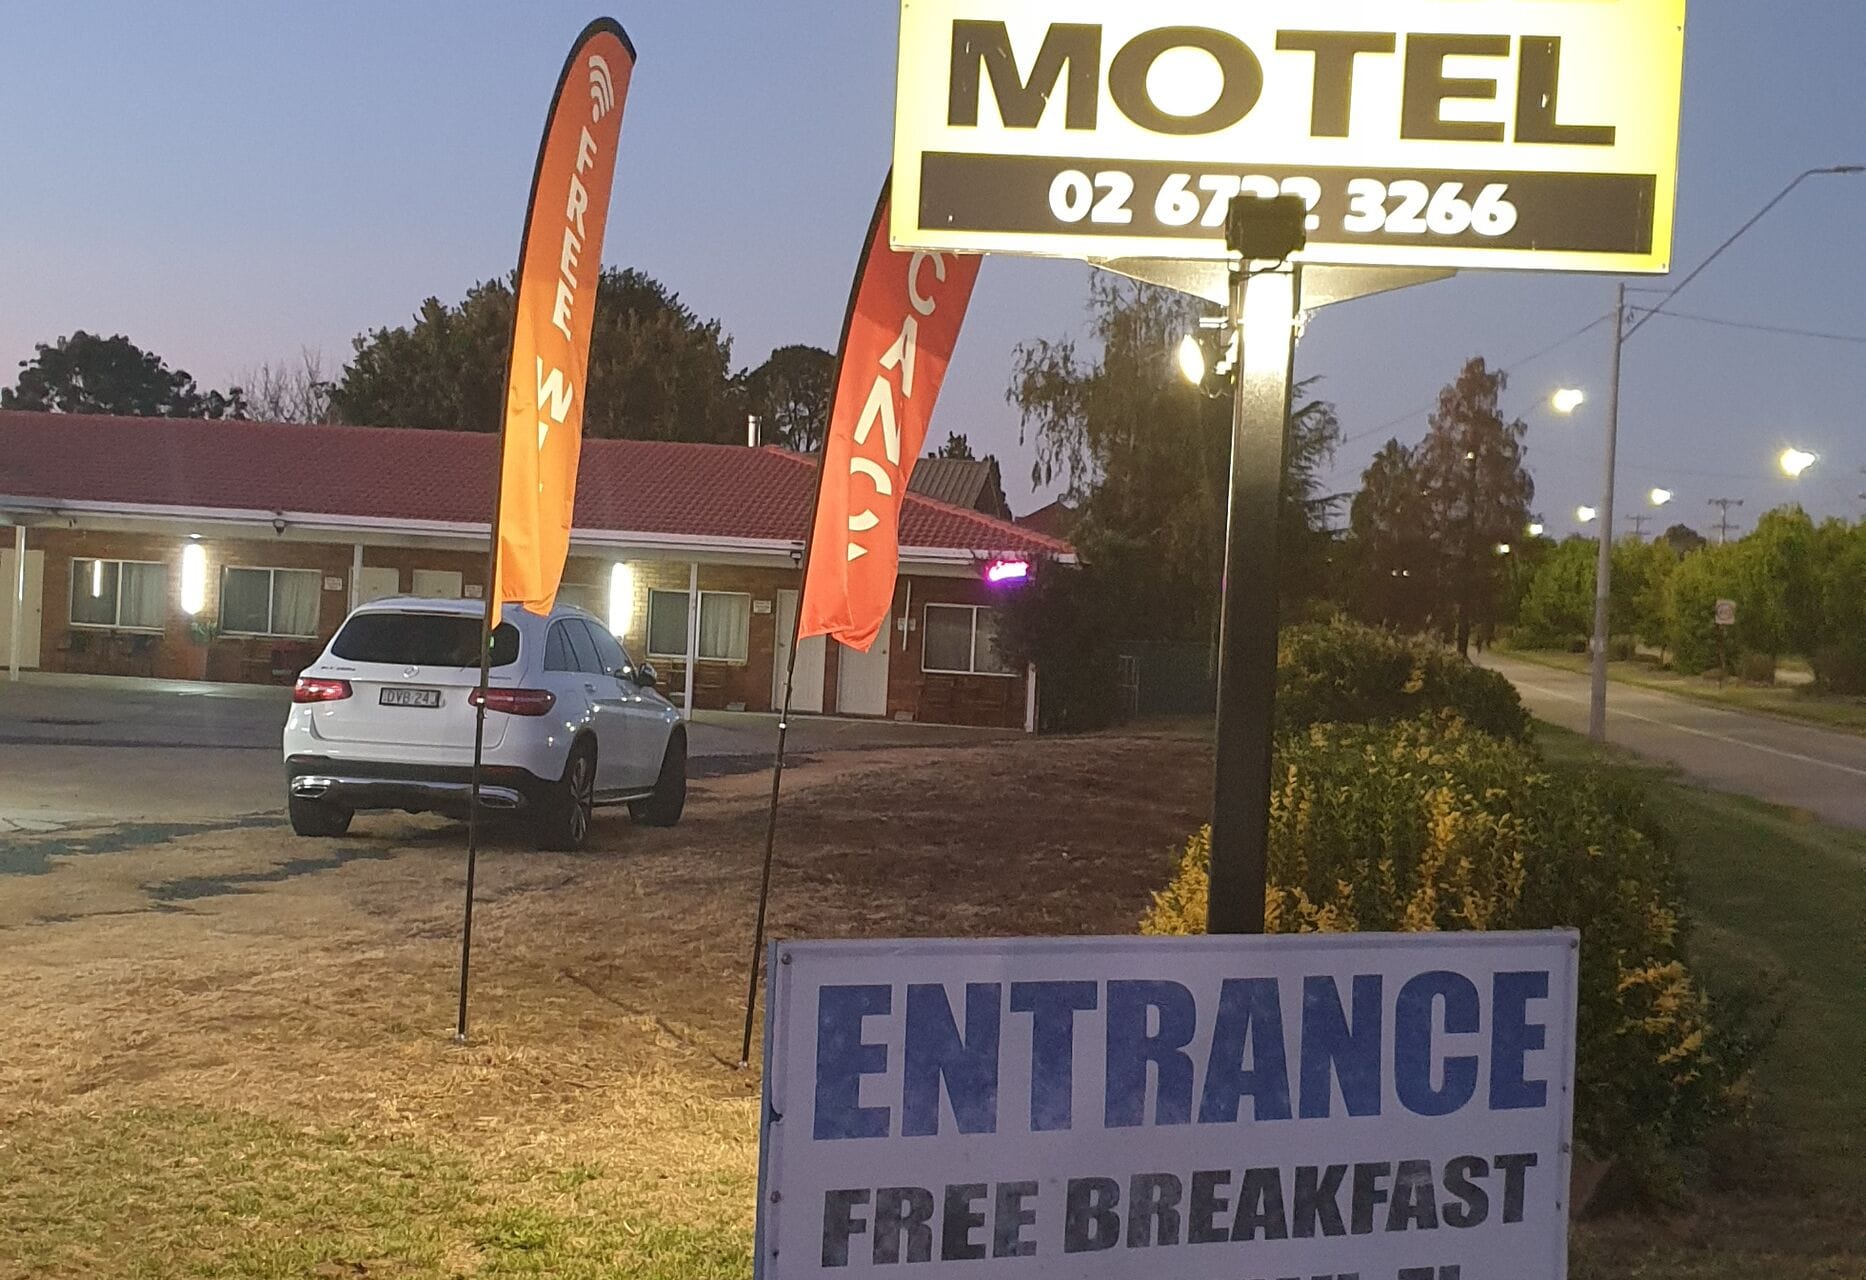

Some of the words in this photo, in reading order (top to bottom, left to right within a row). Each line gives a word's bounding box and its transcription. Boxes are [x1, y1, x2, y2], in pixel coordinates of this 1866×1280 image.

[947, 18, 1617, 148] MOTEL
[552, 125, 598, 342] FREE
[1048, 169, 1135, 224] 02
[1344, 178, 1518, 237] 3266
[812, 970, 1550, 1141] ENTRANCE
[821, 1181, 1039, 1268] FREE
[1063, 1152, 1539, 1254] BREAKFAST
